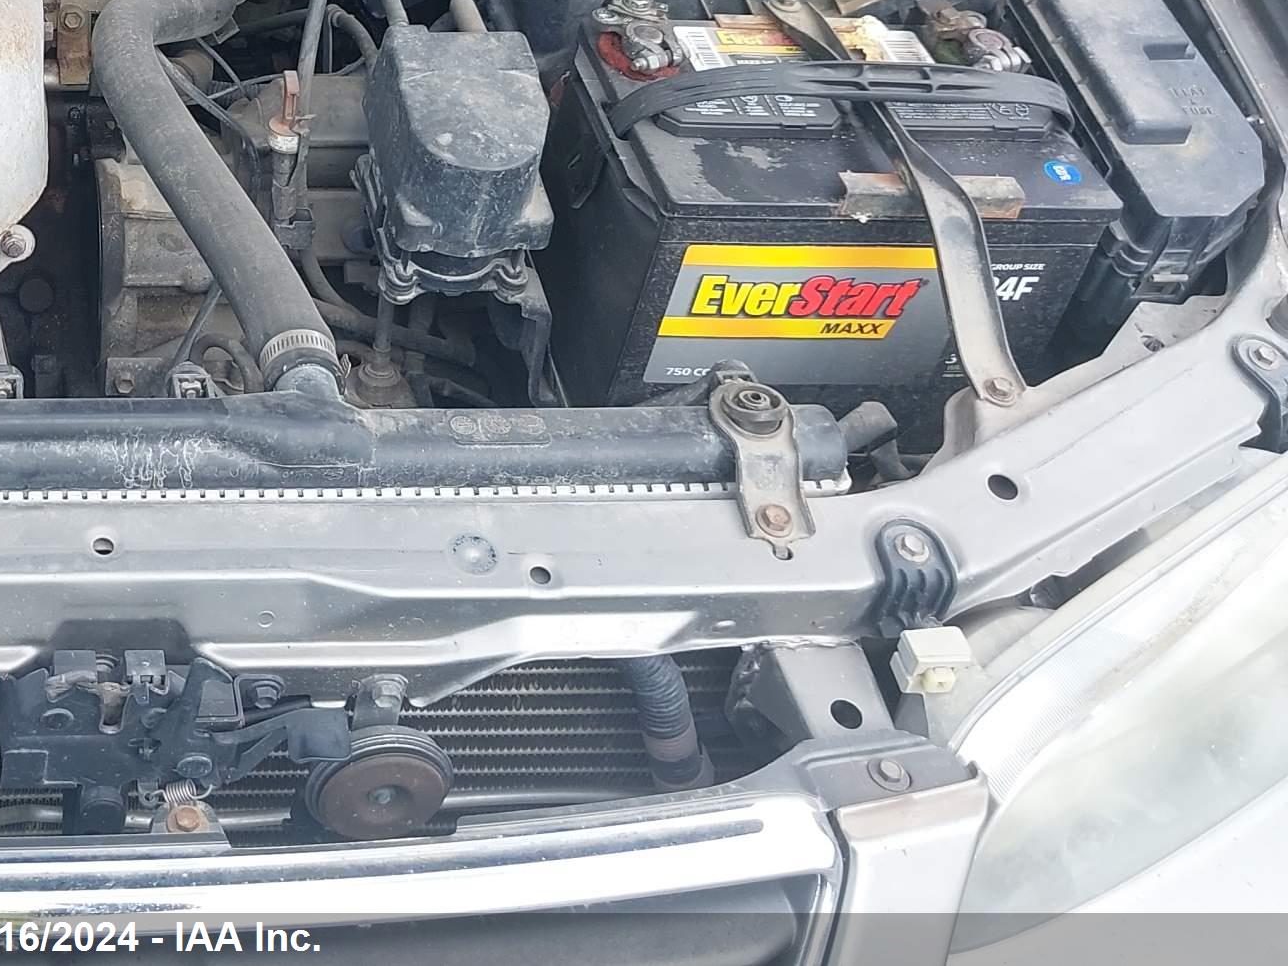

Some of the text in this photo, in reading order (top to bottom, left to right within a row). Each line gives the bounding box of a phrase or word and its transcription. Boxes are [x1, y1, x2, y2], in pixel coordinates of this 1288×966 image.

[991, 263, 1046, 271] GROUP SIZE
[691, 274, 921, 318] EverStart
[819, 322, 883, 335] MAXX
[665, 367, 692, 376] 750
